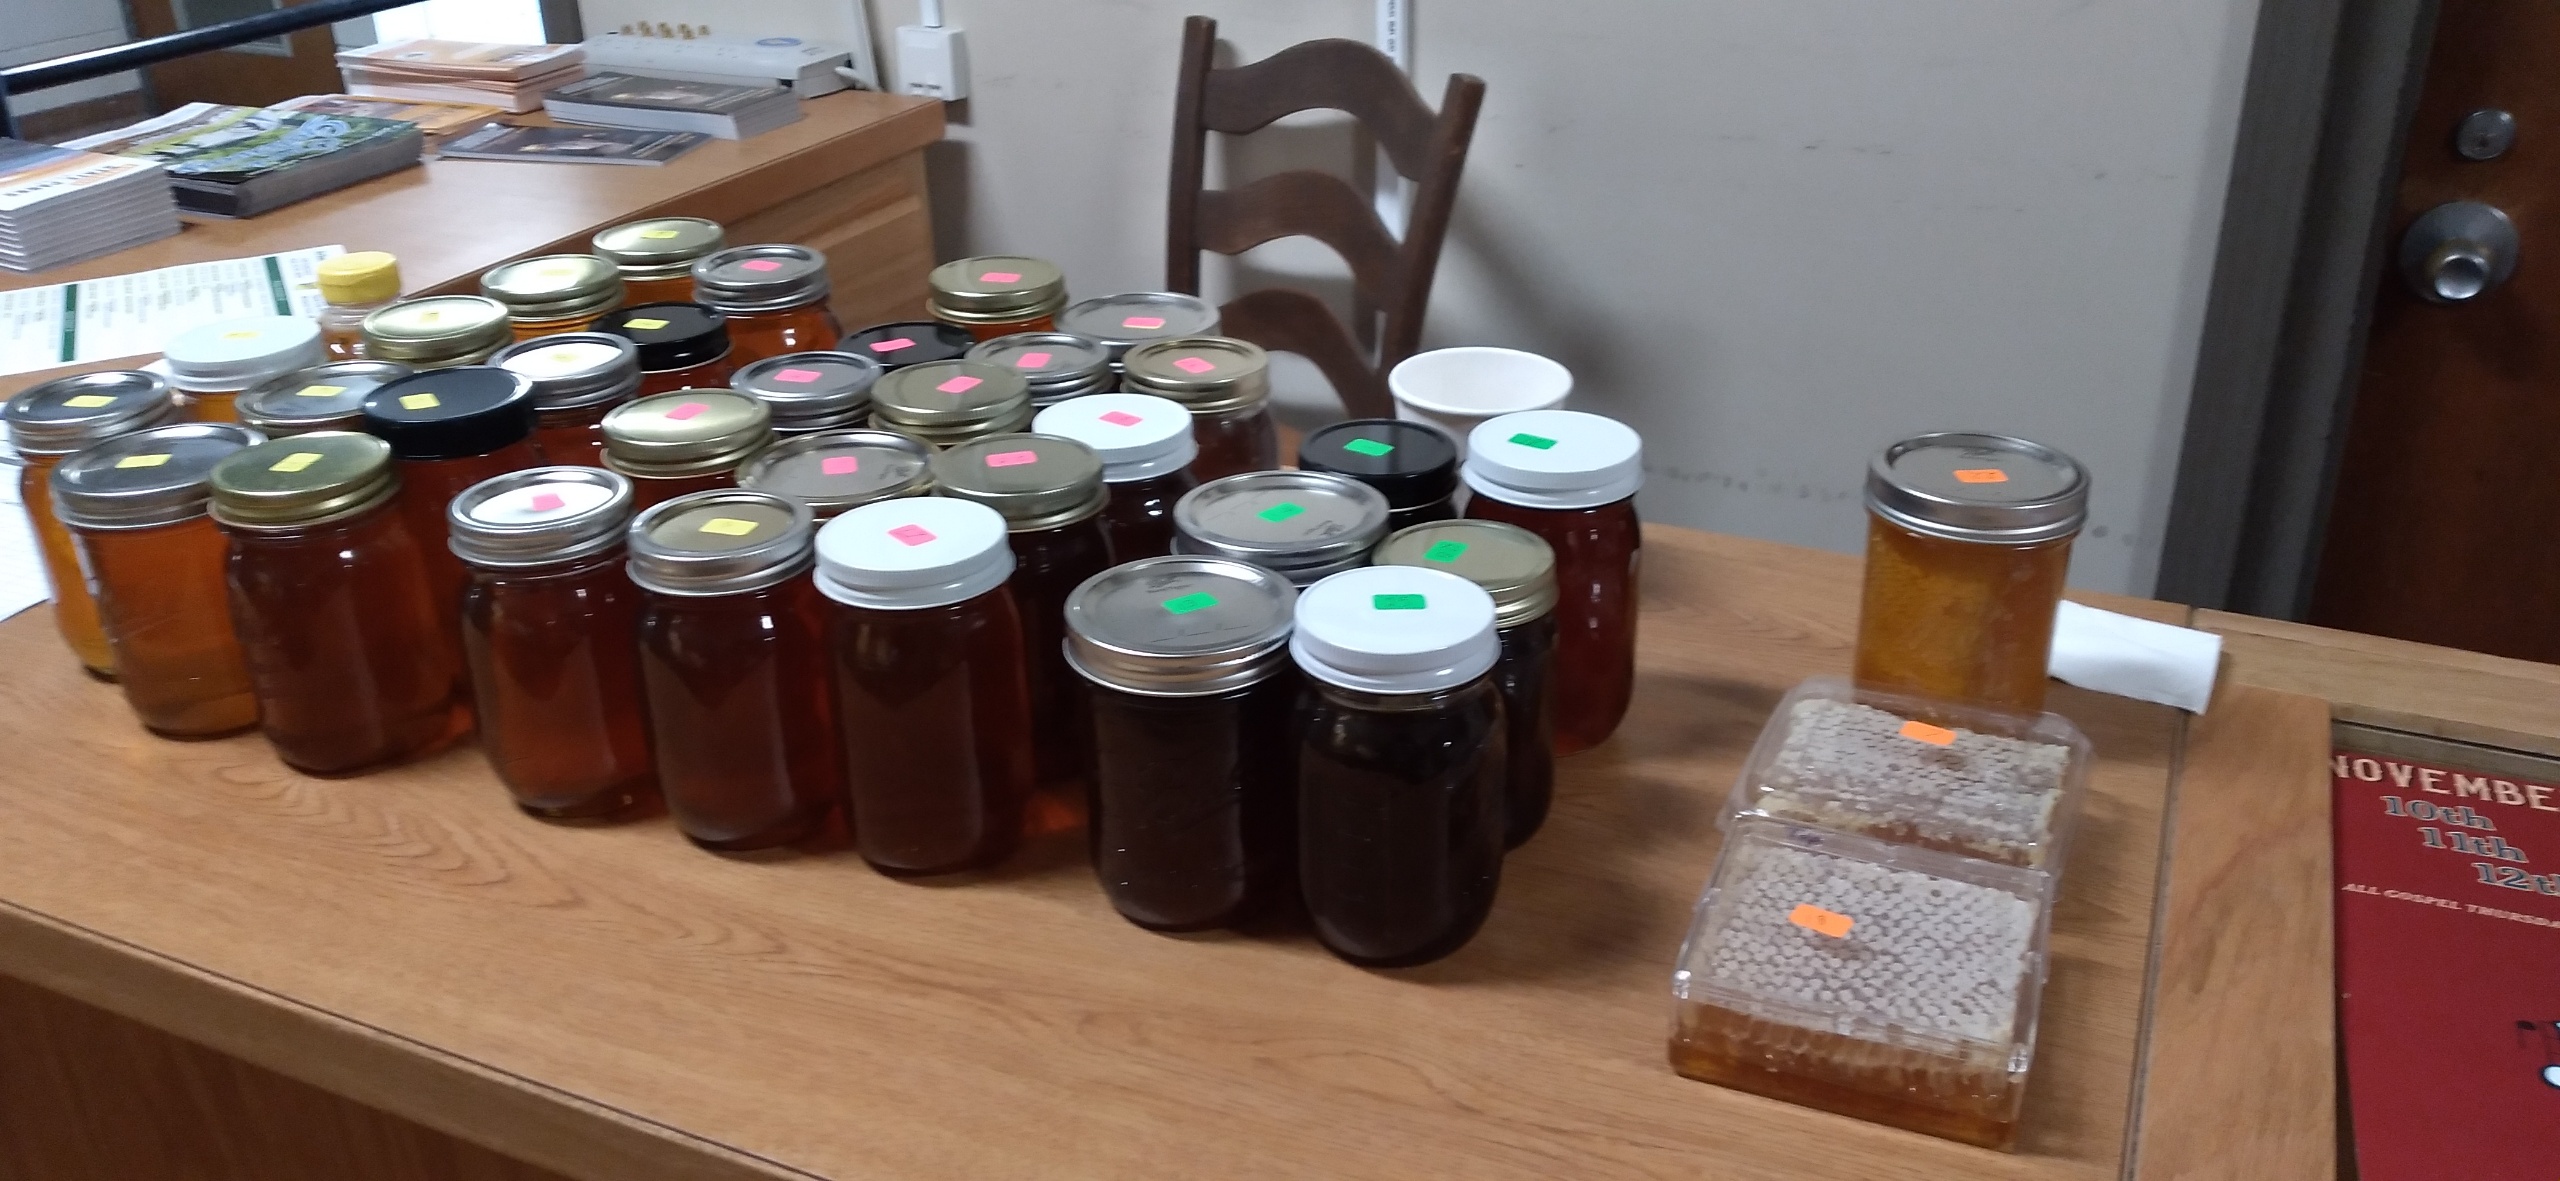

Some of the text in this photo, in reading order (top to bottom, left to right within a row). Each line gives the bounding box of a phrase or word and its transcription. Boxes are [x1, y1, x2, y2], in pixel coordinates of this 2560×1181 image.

[2379, 795, 2497, 831] 10th
[2417, 827, 2529, 863] 11th
[2341, 883, 2381, 895] ALL
[2383, 889, 2462, 910] GOSPEL
